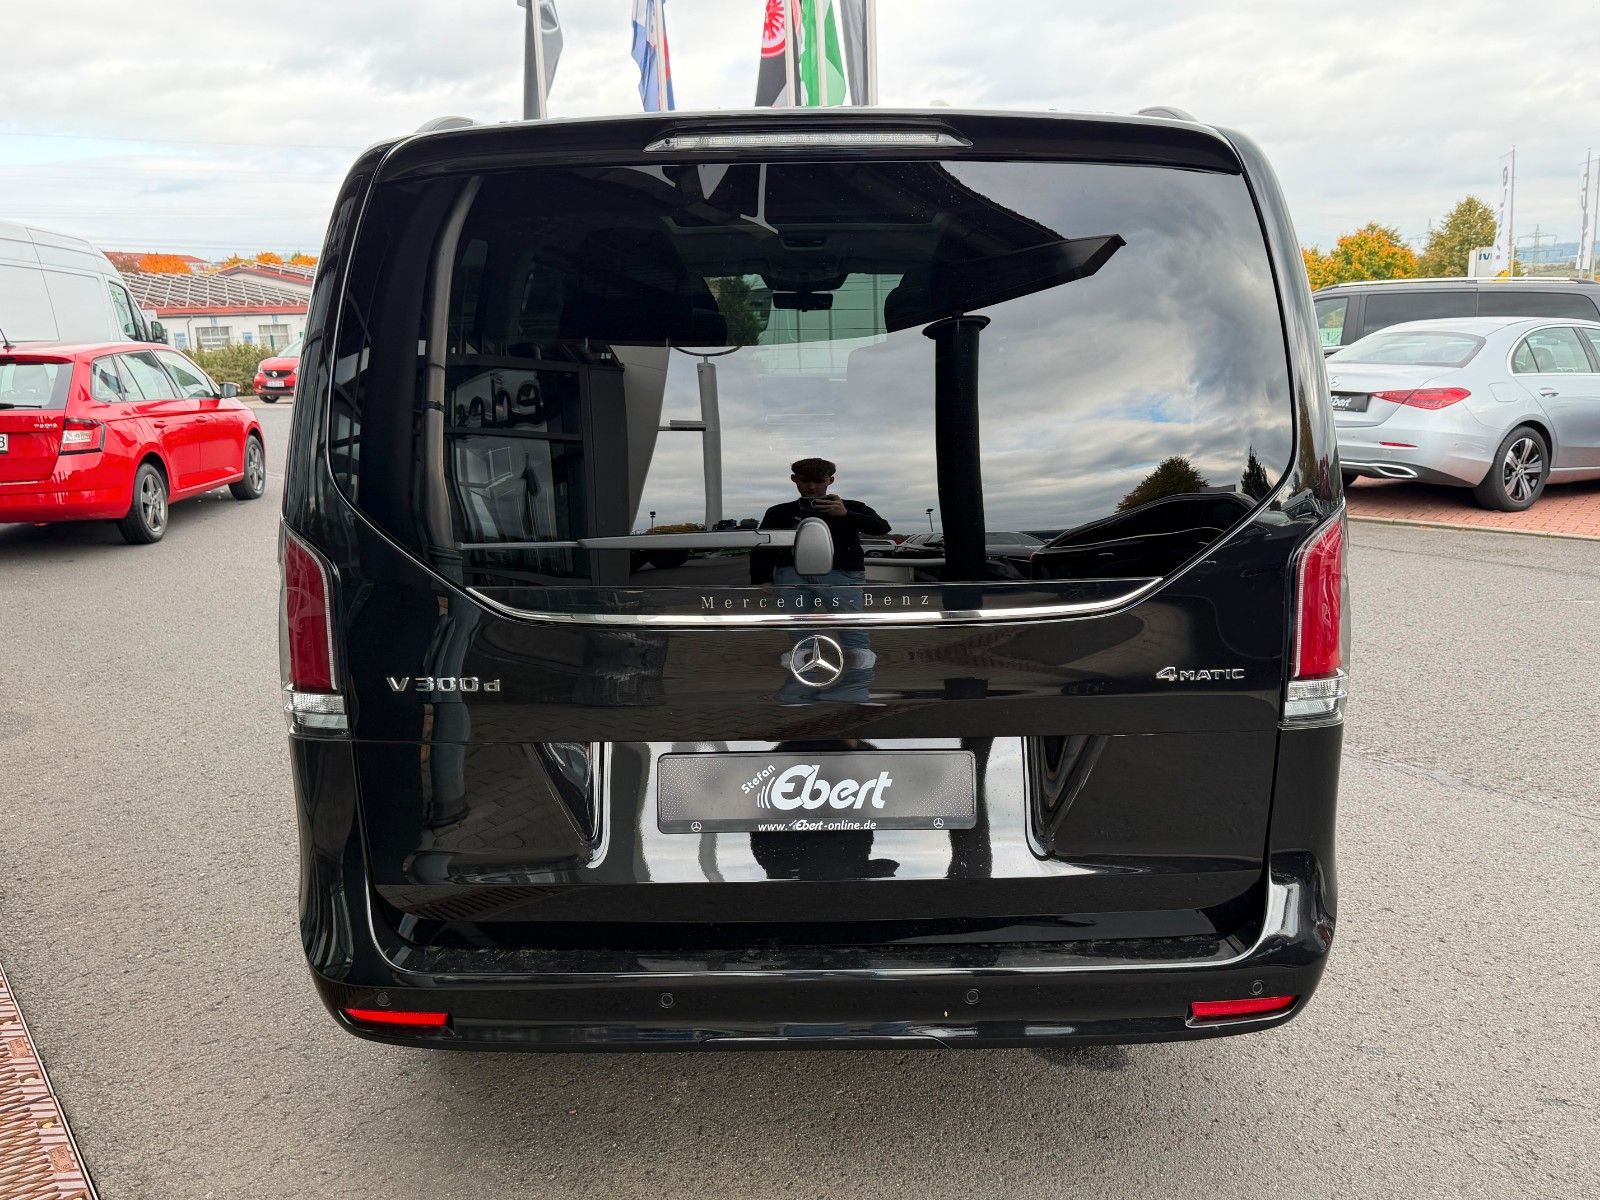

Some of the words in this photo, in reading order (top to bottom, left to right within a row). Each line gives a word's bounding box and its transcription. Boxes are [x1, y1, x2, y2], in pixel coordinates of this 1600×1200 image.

[701, 593, 931, 609] Mercedes-Benz
[1155, 666, 1245, 682] 4MATIC
[741, 764, 776, 795] Stefan
[771, 764, 893, 811] Ebert
